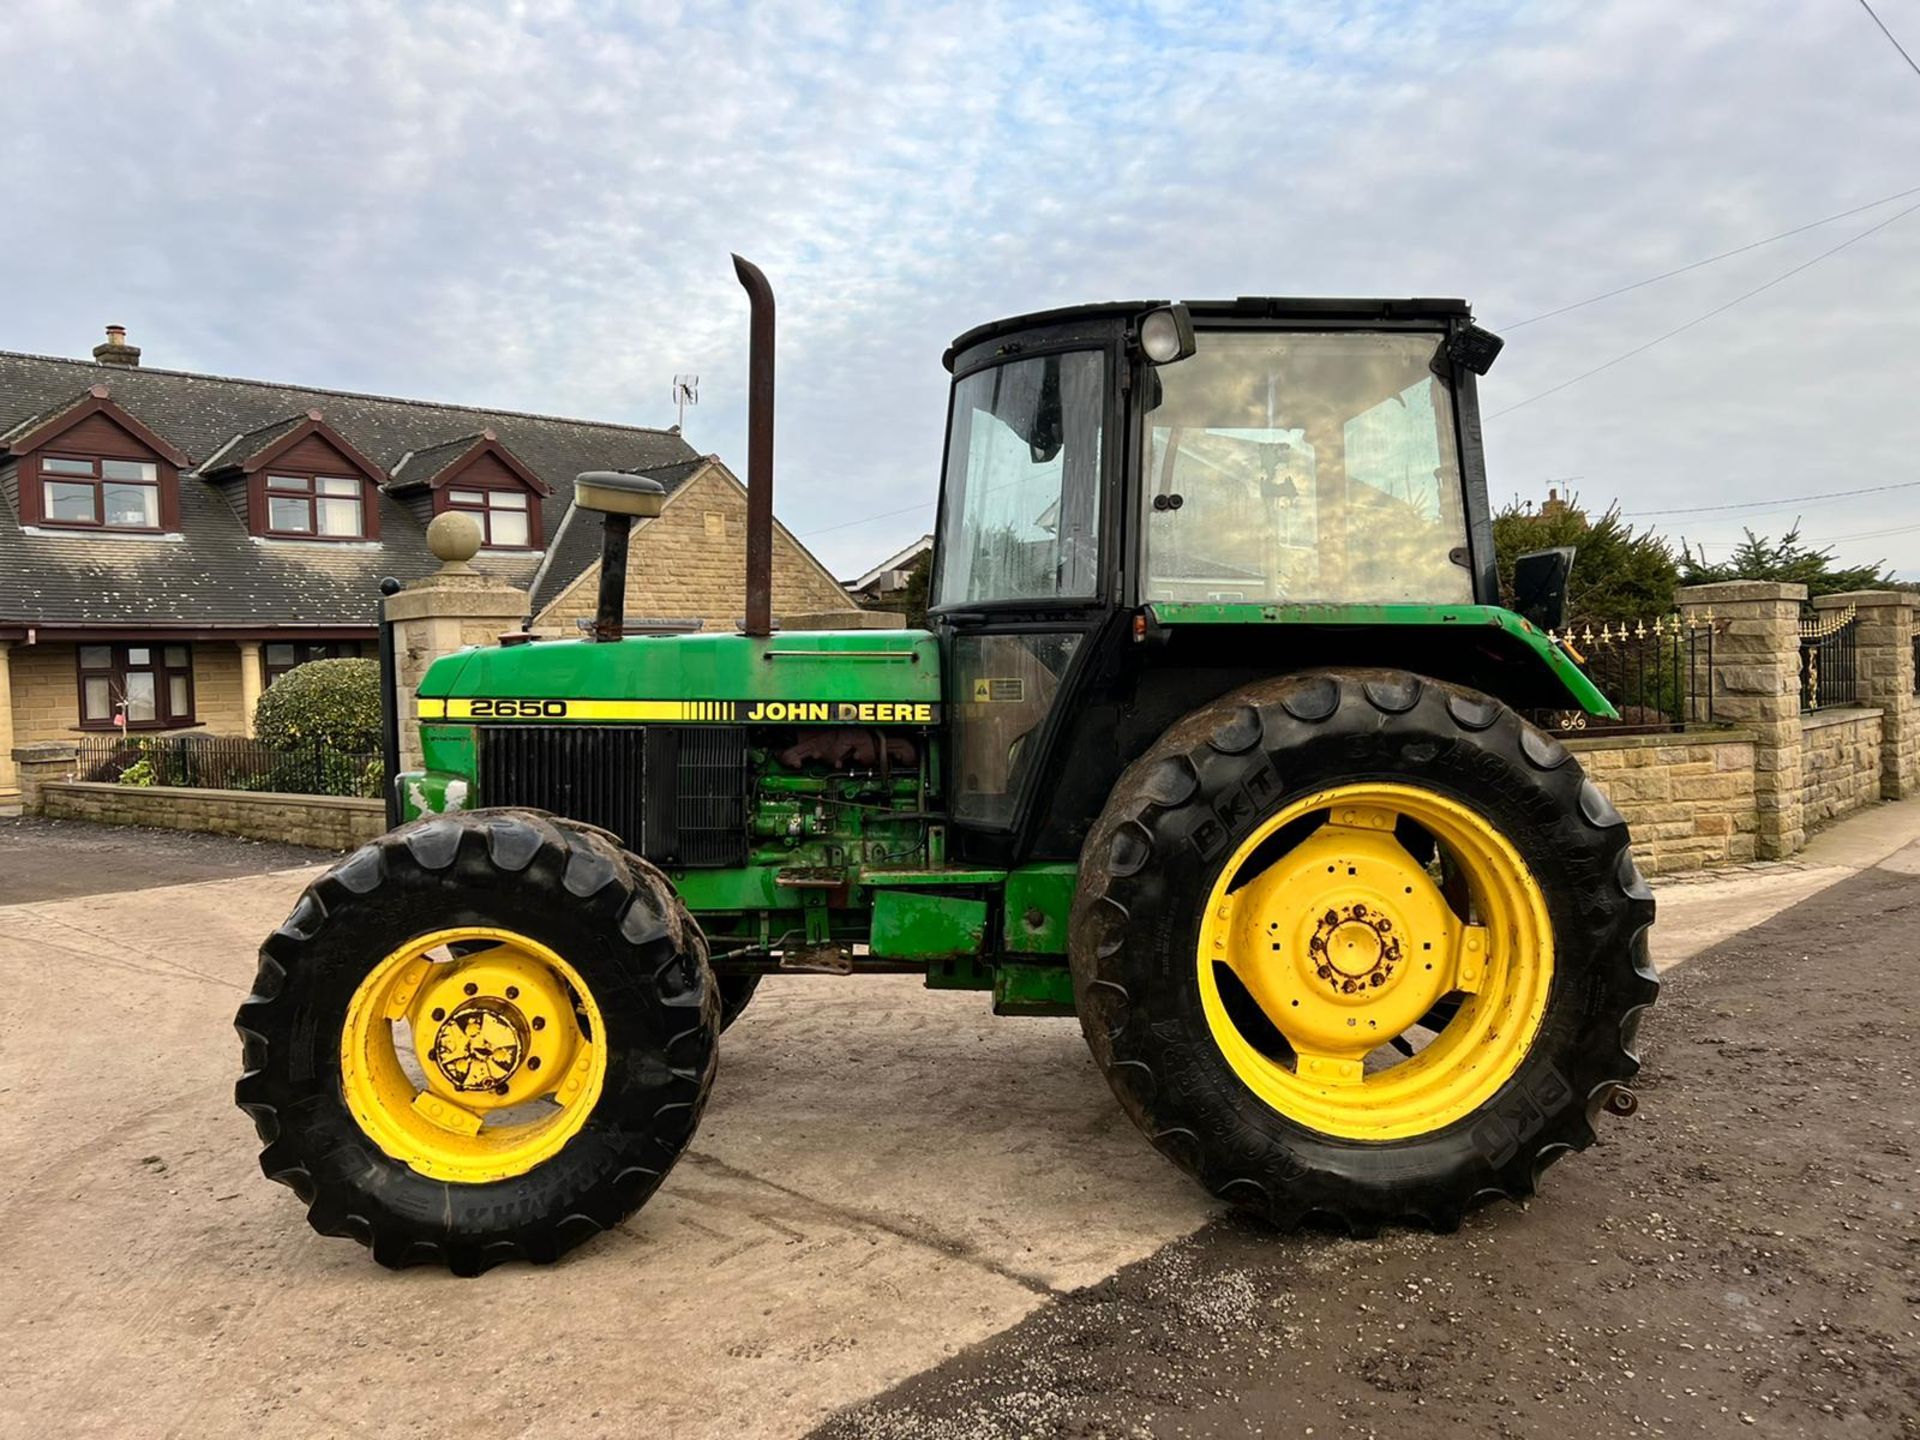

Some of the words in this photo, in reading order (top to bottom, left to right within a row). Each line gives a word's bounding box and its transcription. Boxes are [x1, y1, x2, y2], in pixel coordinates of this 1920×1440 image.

[470, 699, 567, 716] 2650
[747, 702, 829, 721] JOHN
[837, 703, 932, 721] DEERE
[1191, 764, 1273, 855] BKT
